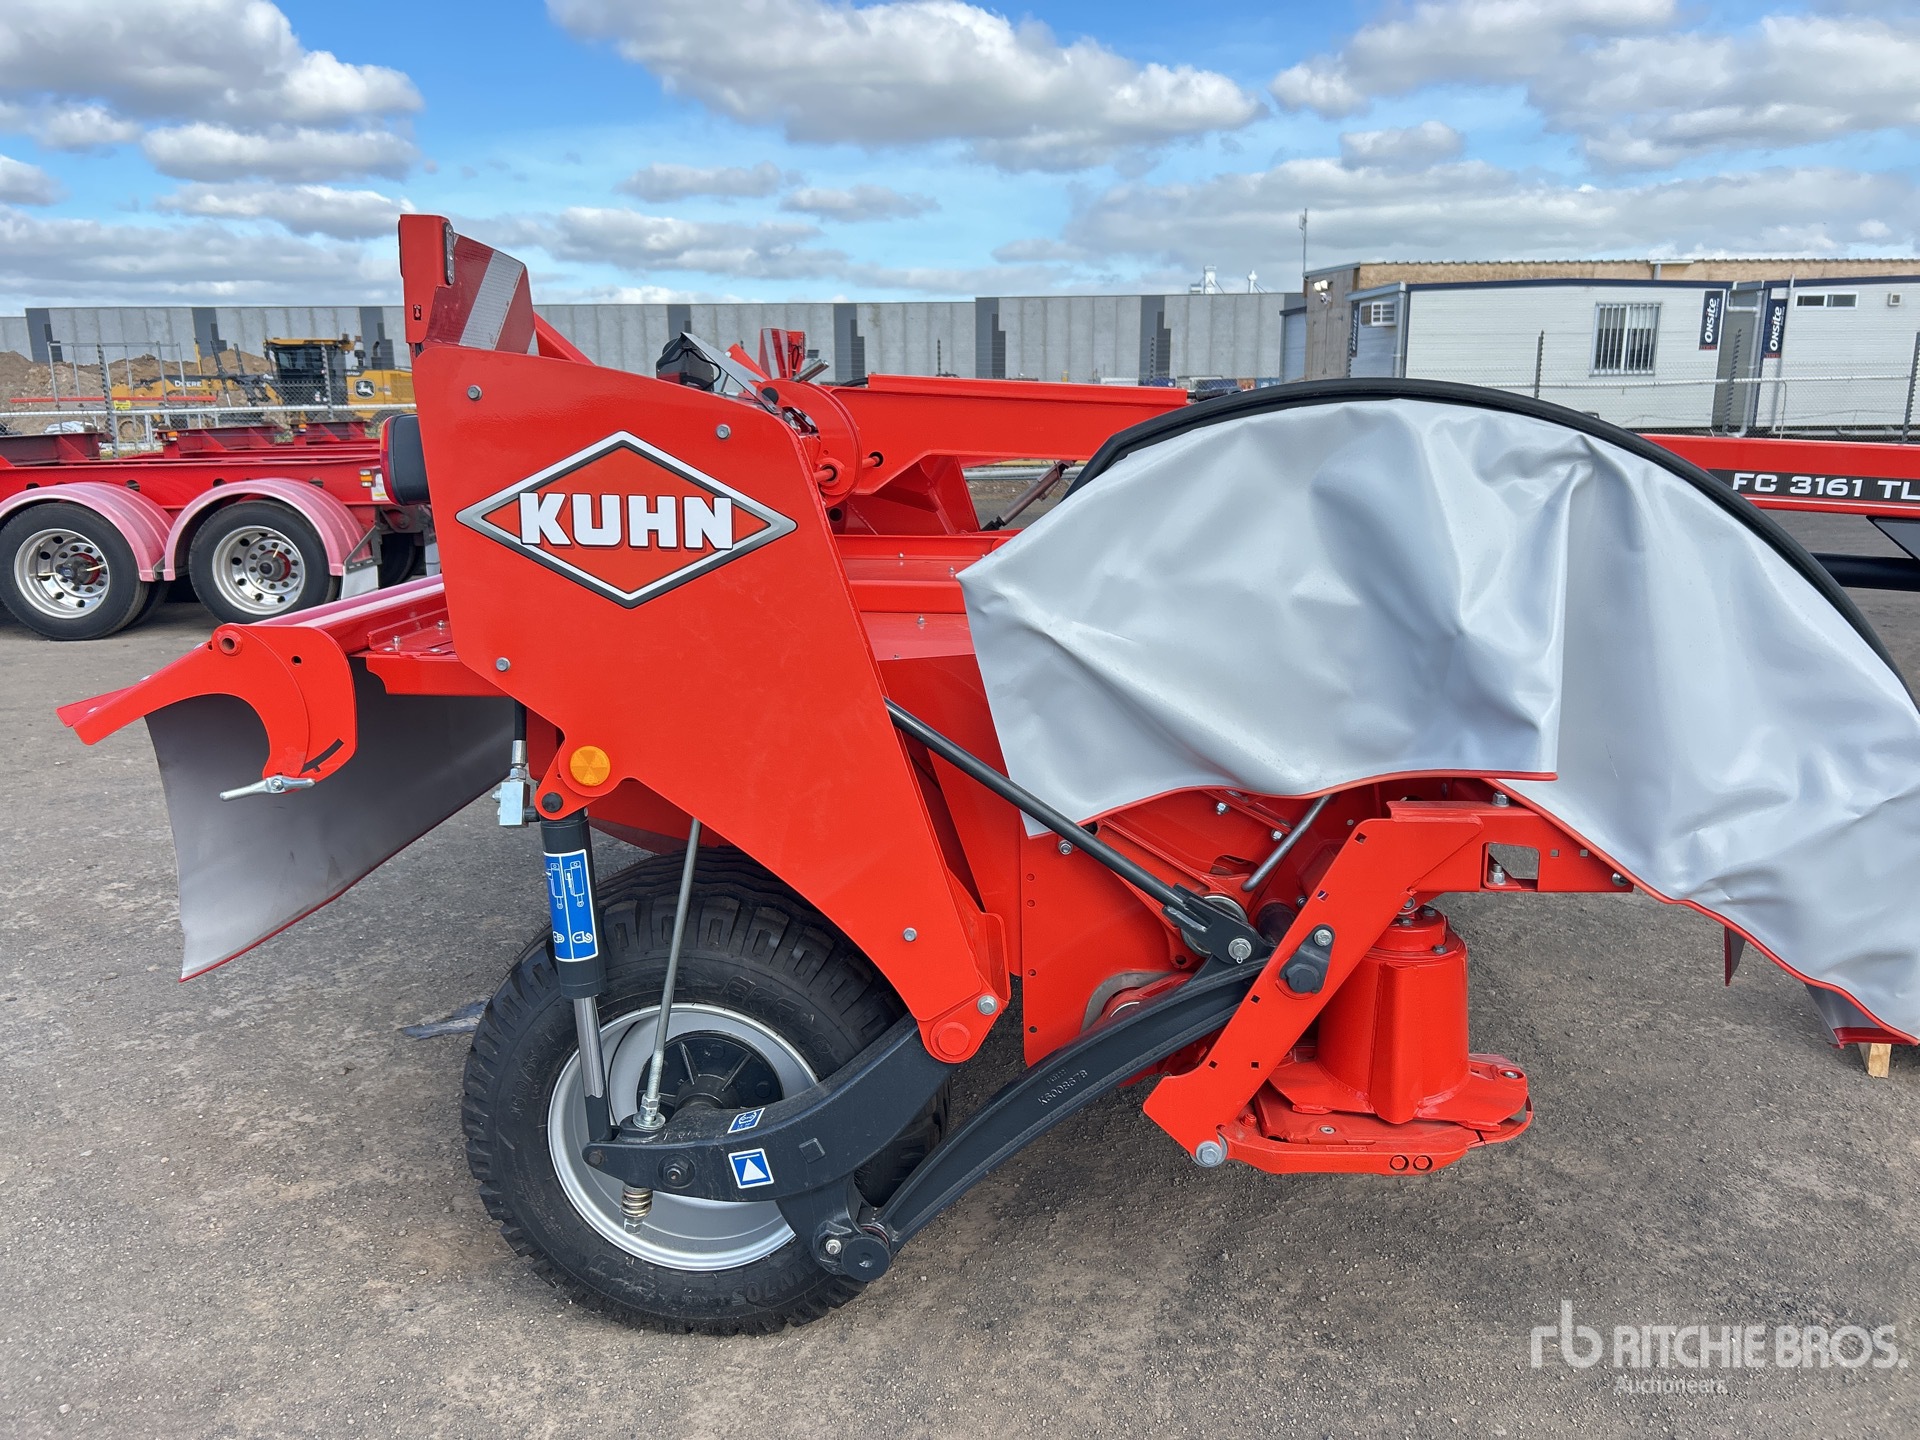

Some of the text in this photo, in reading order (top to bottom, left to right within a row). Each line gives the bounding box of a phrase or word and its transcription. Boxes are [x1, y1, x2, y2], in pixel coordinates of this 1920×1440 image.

[1732, 473, 1777, 493] FC
[1789, 476, 1863, 497] 3161
[518, 492, 734, 550] KUHN
